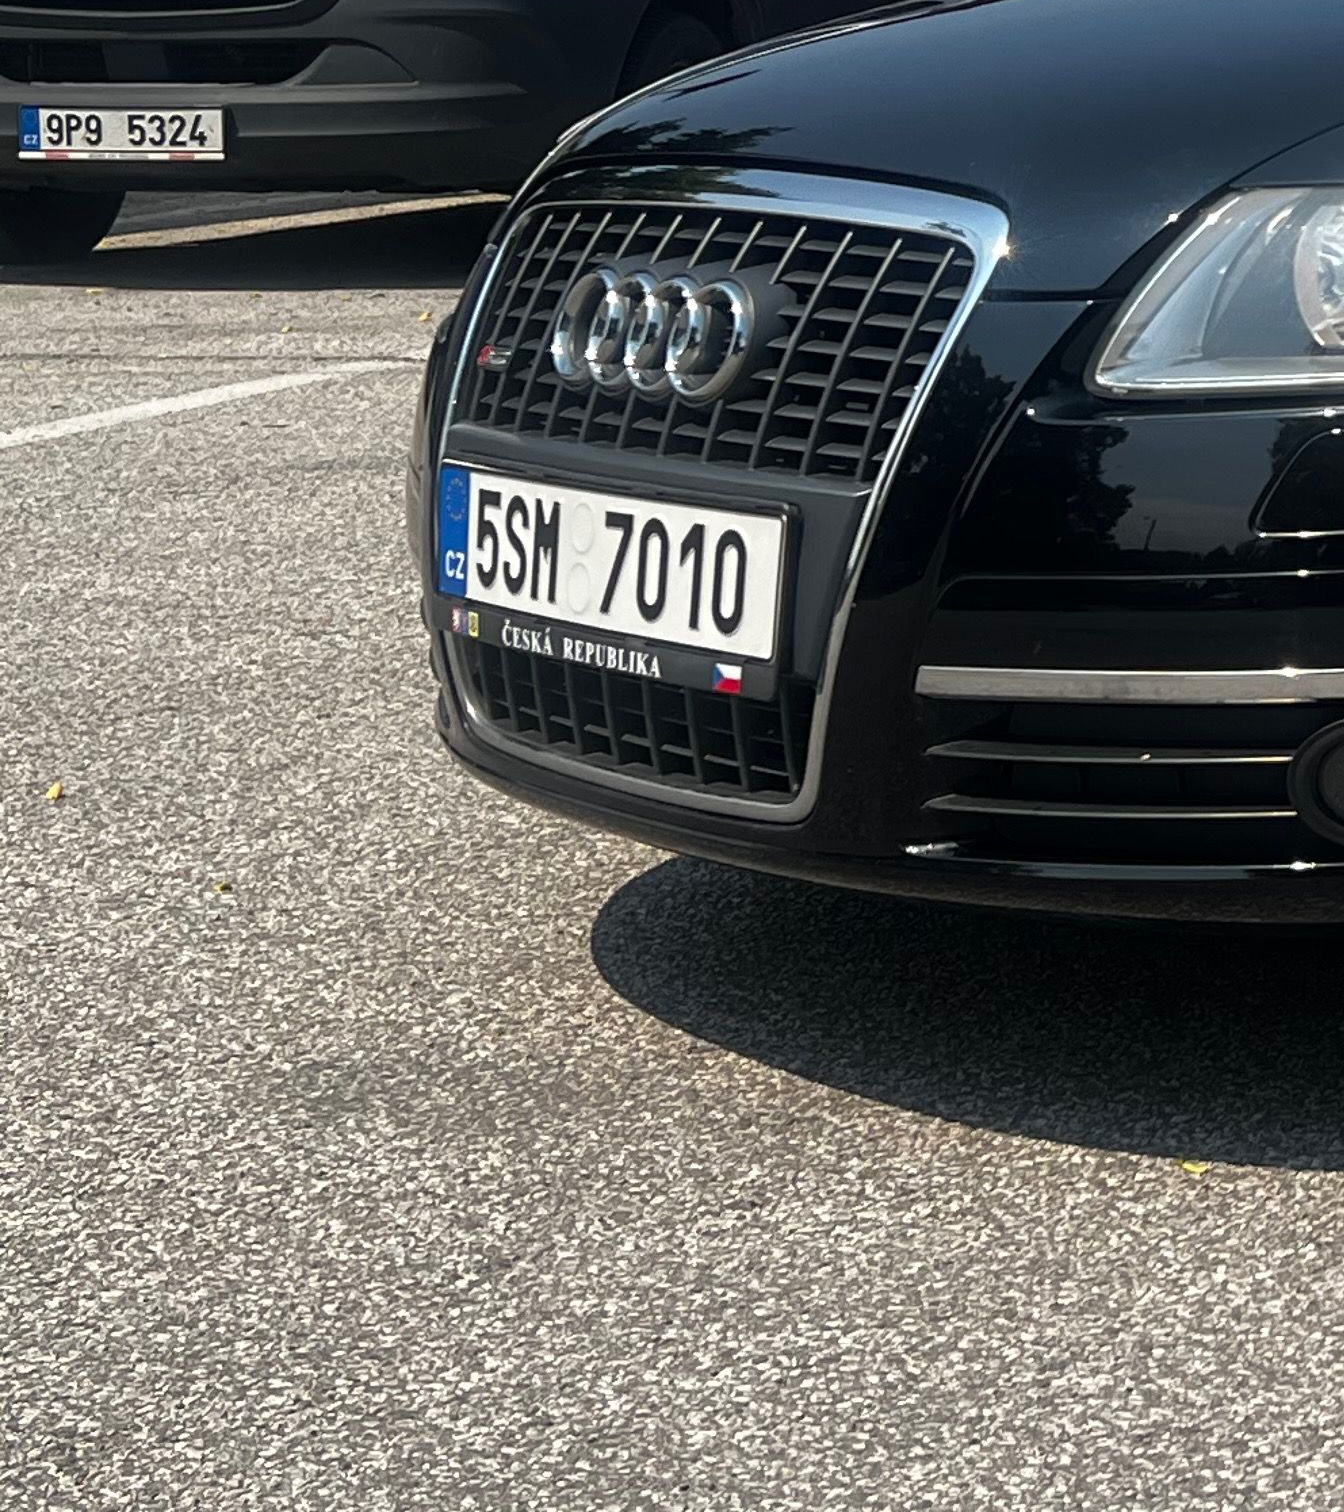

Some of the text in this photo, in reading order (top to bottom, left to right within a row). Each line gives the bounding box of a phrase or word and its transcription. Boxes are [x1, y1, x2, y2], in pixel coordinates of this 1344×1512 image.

[23, 114, 208, 147] CZ 9P9 5324
[445, 488, 747, 635] CZ 5SM 7010
[501, 620, 662, 679] ČESKÁ REPUBLIKA
